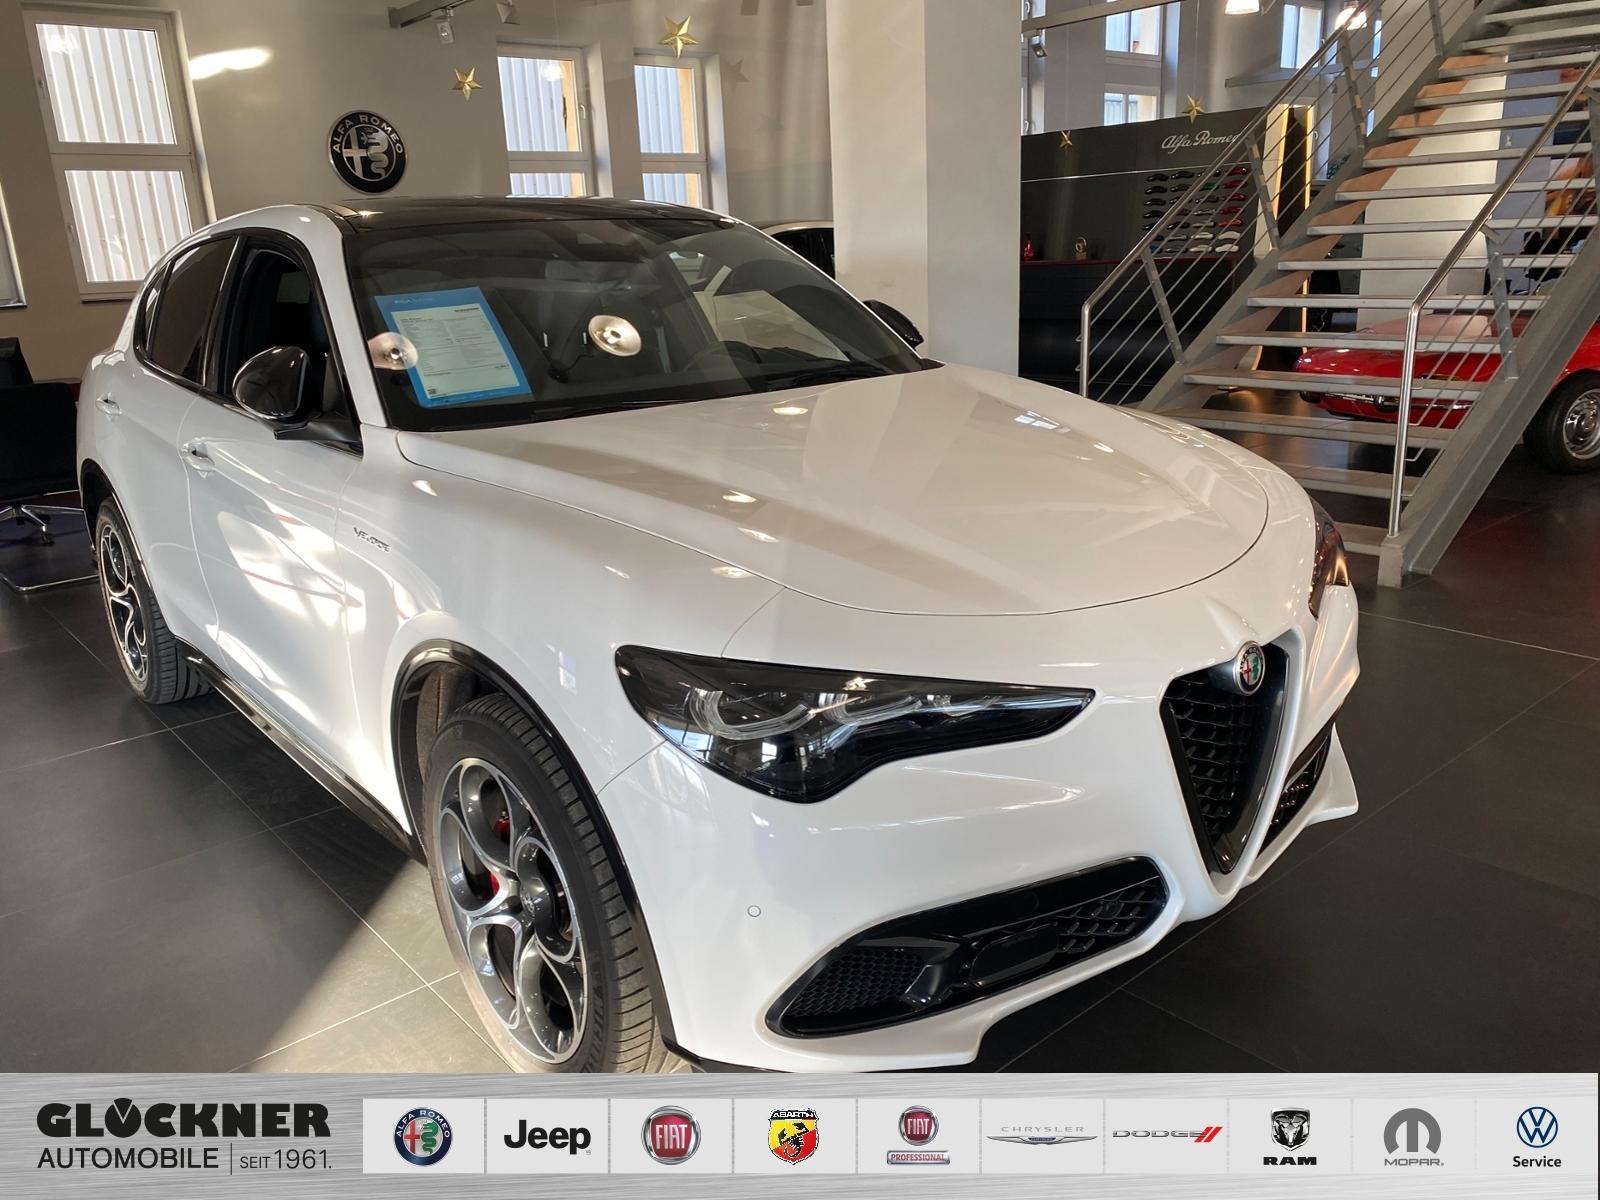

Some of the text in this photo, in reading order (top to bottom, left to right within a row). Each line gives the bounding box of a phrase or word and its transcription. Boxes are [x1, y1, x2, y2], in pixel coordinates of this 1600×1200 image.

[333, 115, 403, 154] ALFA ROMEO
[1162, 134, 1191, 154] Alfa
